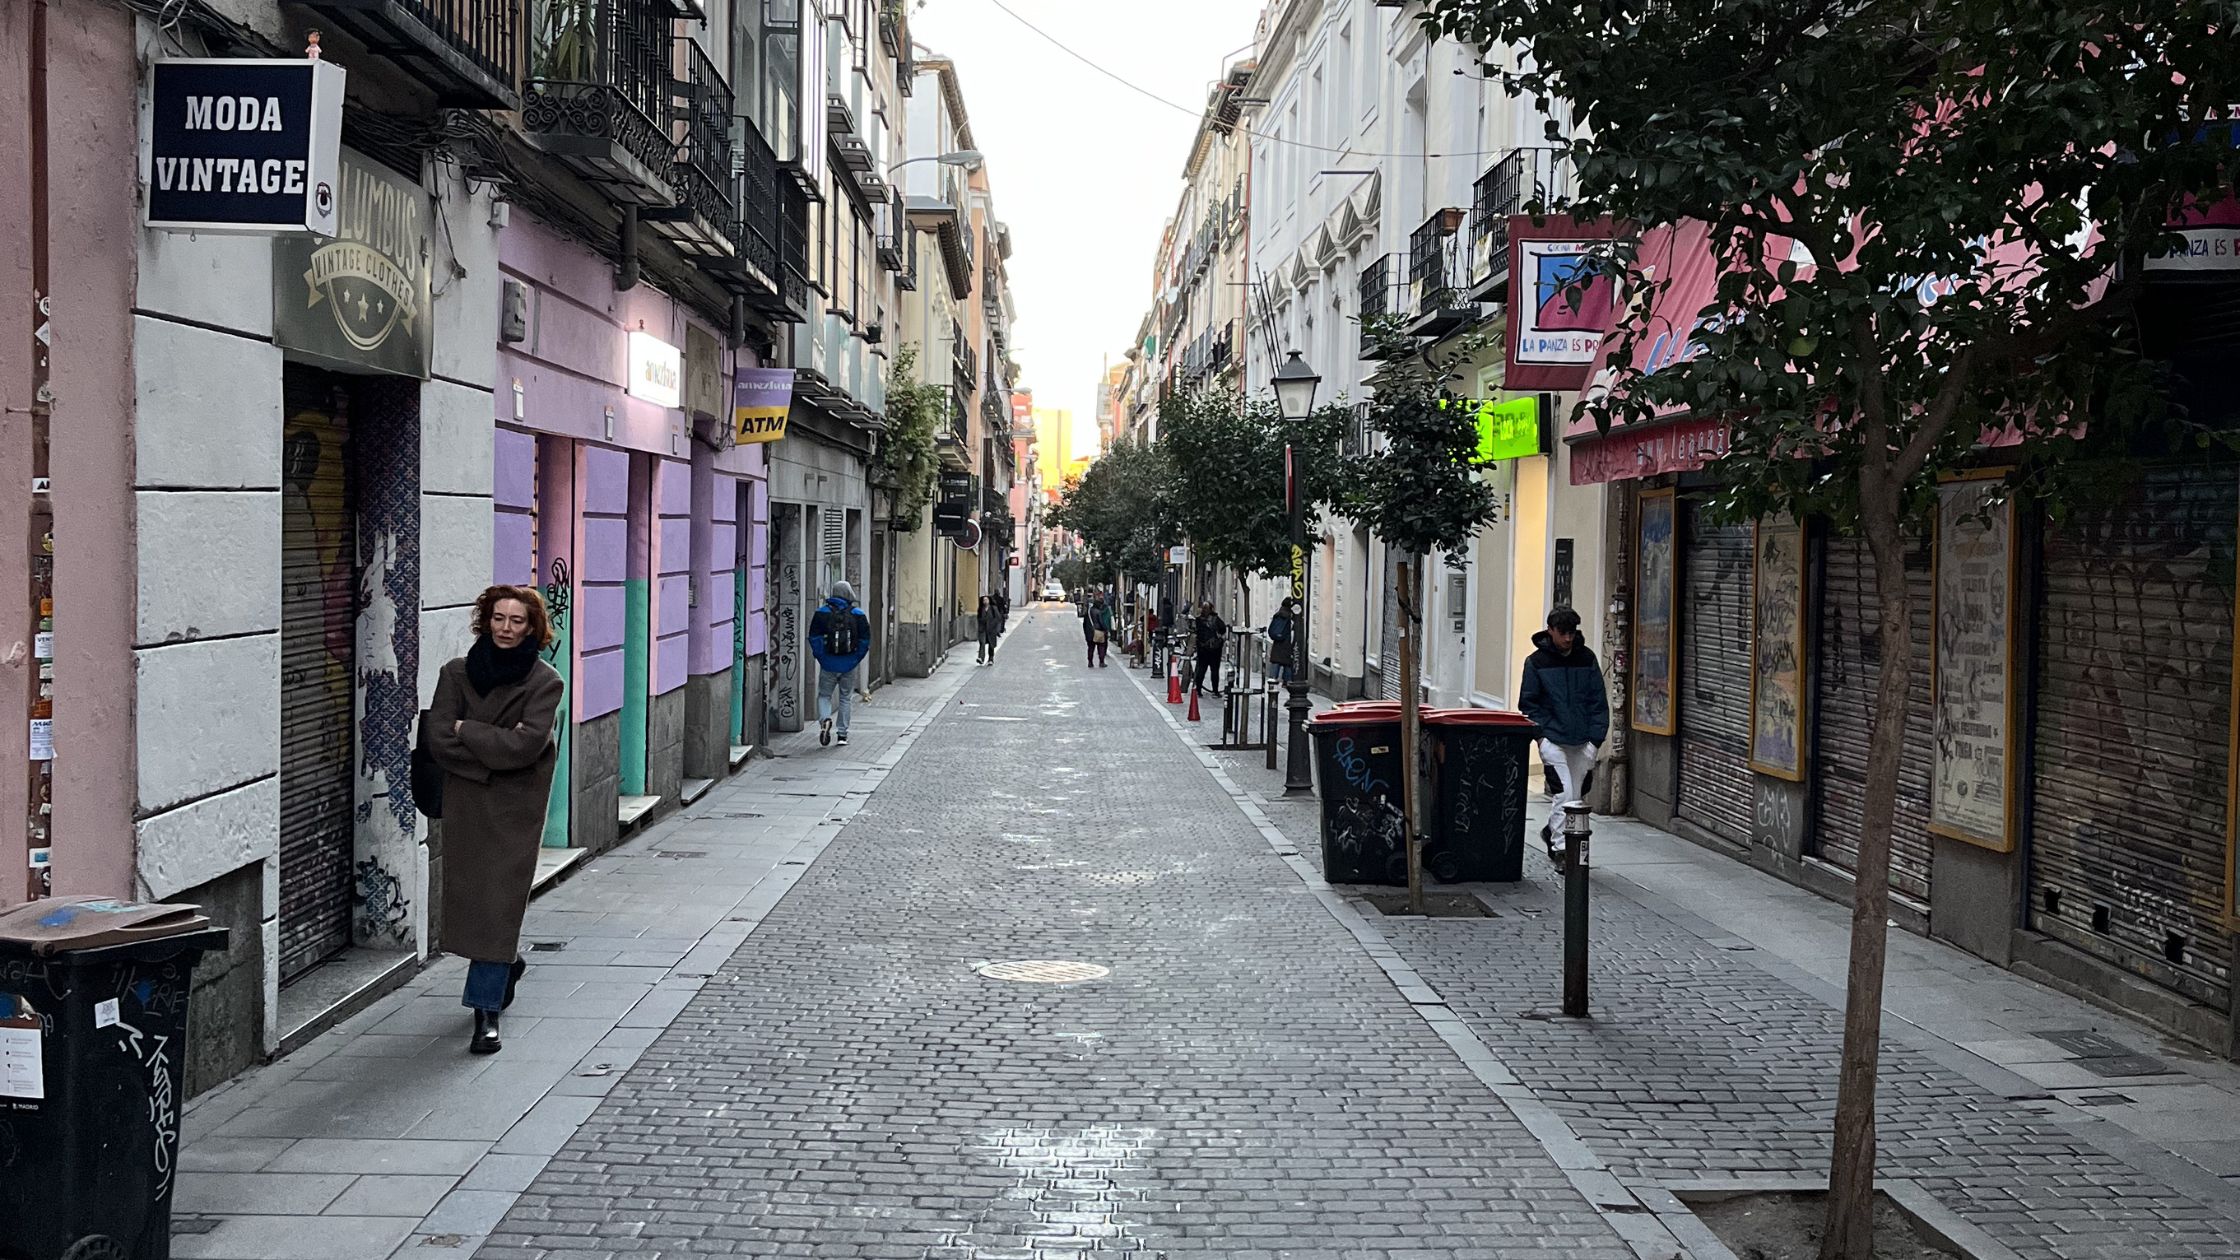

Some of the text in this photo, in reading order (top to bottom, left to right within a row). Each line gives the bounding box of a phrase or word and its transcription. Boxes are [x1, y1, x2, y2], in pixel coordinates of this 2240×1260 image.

[185, 95, 282, 132] MODA
[156, 156, 306, 195] VINTAGE
[336, 160, 416, 282] LUMBUS
[314, 249, 411, 307] VINTAGE CLOTHES
[1522, 338, 1535, 353] LA
[1539, 338, 1568, 353] PANZA
[1572, 338, 1581, 352] ES
[740, 416, 785, 435] ATM
